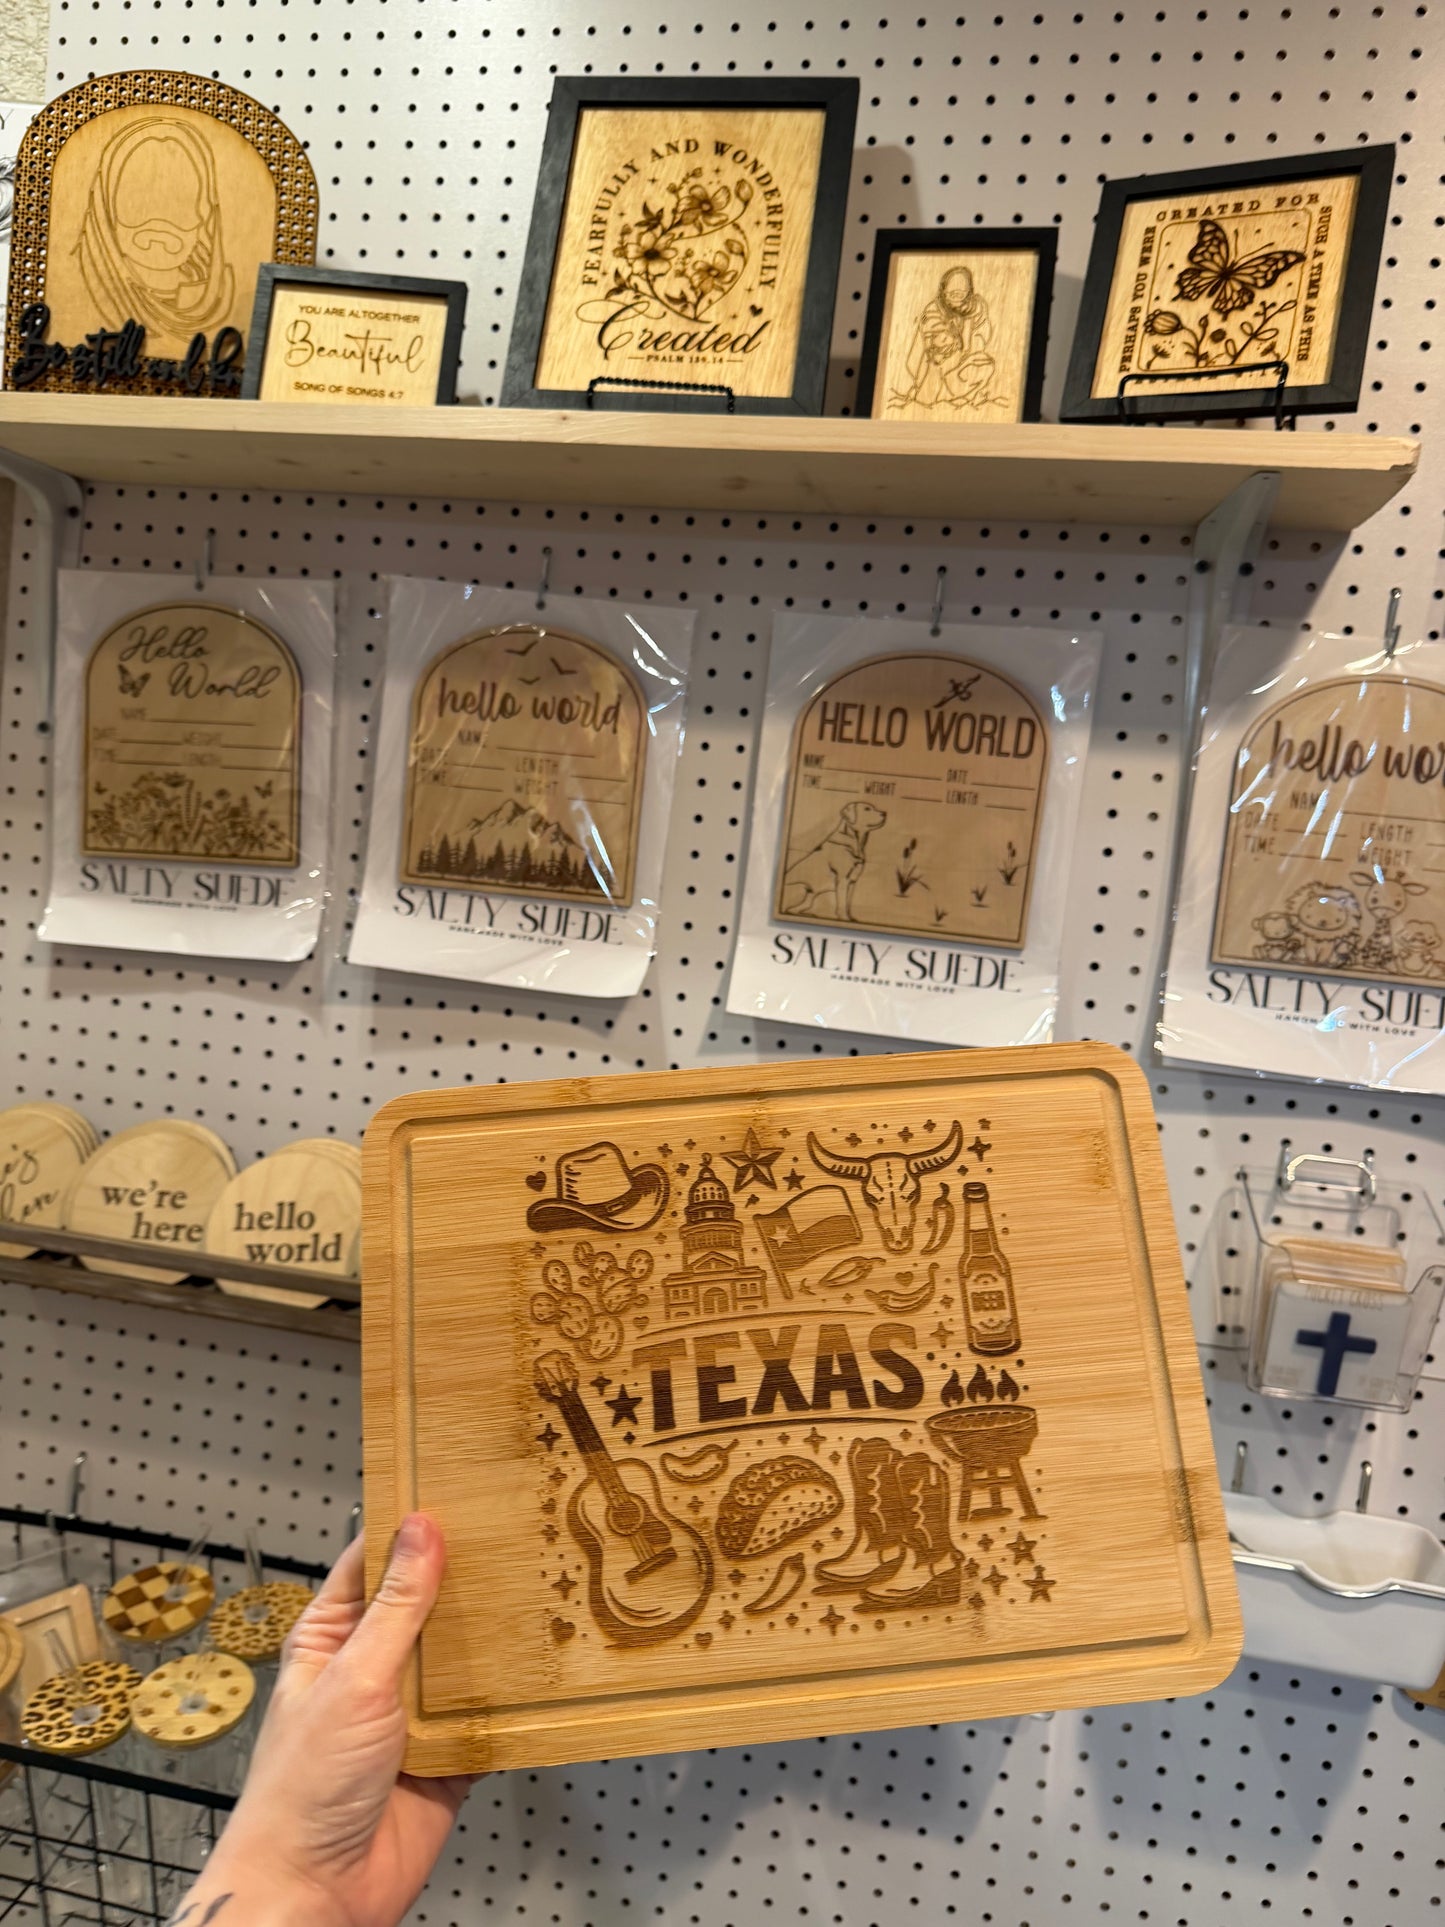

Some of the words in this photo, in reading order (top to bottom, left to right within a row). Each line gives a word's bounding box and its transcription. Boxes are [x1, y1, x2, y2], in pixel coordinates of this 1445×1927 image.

[582, 158, 641, 286] FEARFULLY
[649, 137, 700, 163] AND
[713, 140, 785, 290] WONDERFULLY
[1156, 199, 1261, 221] CREATED
[1274, 192, 1320, 208] FOR
[1315, 205, 1332, 244] SUCH
[1138, 225, 1157, 268] WERE
[1312, 250, 1325, 260] A
[1131, 272, 1148, 302] YOU
[1306, 262, 1323, 300] TIME
[299, 305, 322, 315] YOU
[323, 307, 345, 317] ARE
[349, 310, 421, 323] ALTOGETHER
[576, 299, 772, 360] Created
[1303, 304, 1316, 323] AS
[284, 319, 424, 375] Beautiful
[1119, 306, 1142, 373] PERHAPS
[1297, 327, 1312, 362] THIS
[646, 355, 684, 363] PSALM
[293, 381, 325, 392] SONG
[328, 384, 343, 393] OF
[346, 386, 385, 398] SONGS
[119, 626, 210, 663] Hello
[168, 662, 280, 698] World
[438, 678, 522, 722] hello
[532, 693, 621, 734] world
[458, 729, 487, 748] NAM
[817, 701, 909, 749] HELLO
[924, 709, 1035, 760] WORLD
[1269, 720, 1373, 783] hello
[80, 863, 182, 898] SALTY
[193, 872, 296, 907] SUEDE
[393, 887, 507, 928] SALTY
[518, 903, 628, 945] SUEDE
[771, 933, 892, 976] SALTY
[904, 948, 1025, 993] SUEDE
[831, 974, 890, 987] HANDMADE
[896, 981, 923, 991] WITH
[927, 985, 956, 995] LOVE
[1207, 969, 1345, 1016] SALTY
[1358, 986, 1445, 1030] SUE
[1349, 1022, 1380, 1033] WITH
[1385, 1026, 1416, 1037] LOVE
[101, 1180, 189, 1210] we're
[132, 1213, 204, 1243] here
[234, 1201, 316, 1231] hello
[246, 1233, 344, 1264] world
[632, 1322, 926, 1433] TEXAS
